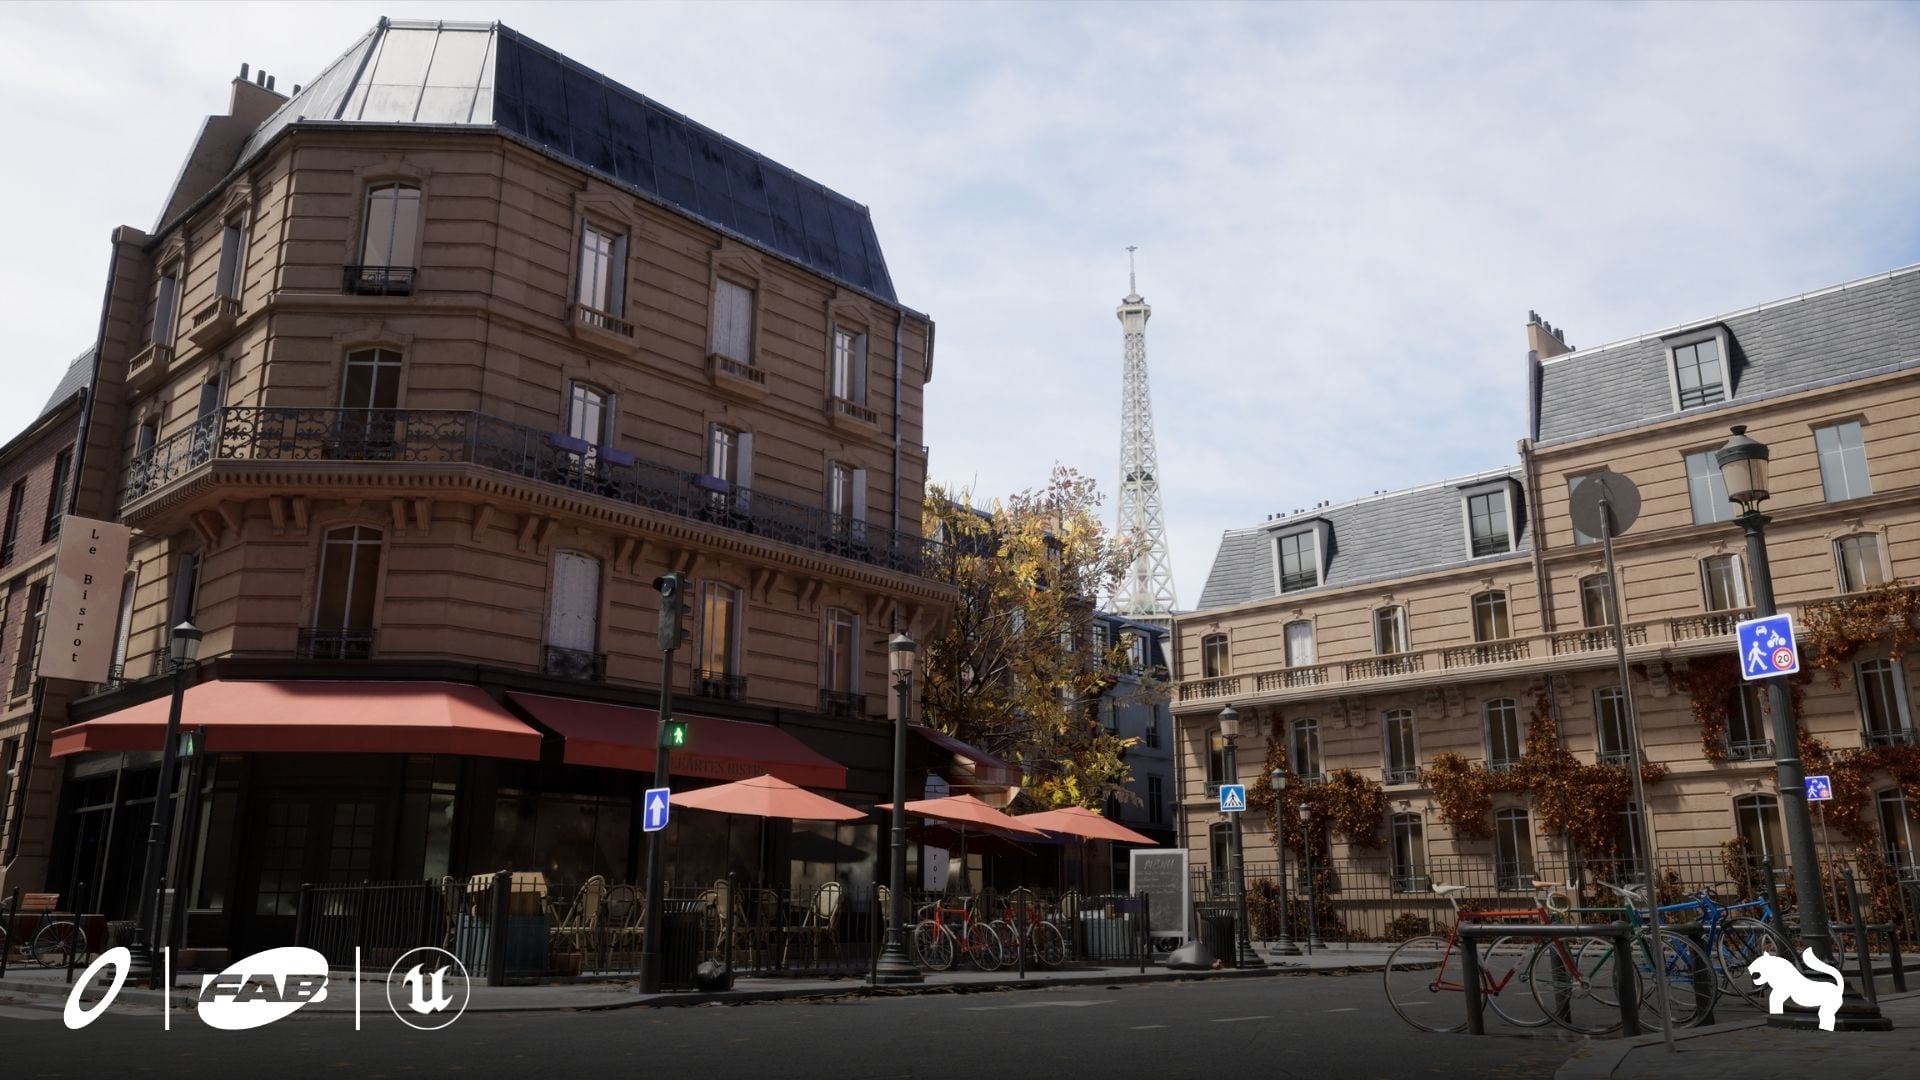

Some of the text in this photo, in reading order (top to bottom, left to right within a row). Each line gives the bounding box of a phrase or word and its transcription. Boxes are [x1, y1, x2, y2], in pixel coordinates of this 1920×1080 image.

[72, 528, 99, 662] Le Bisrot
[1777, 654, 1789, 664] 20
